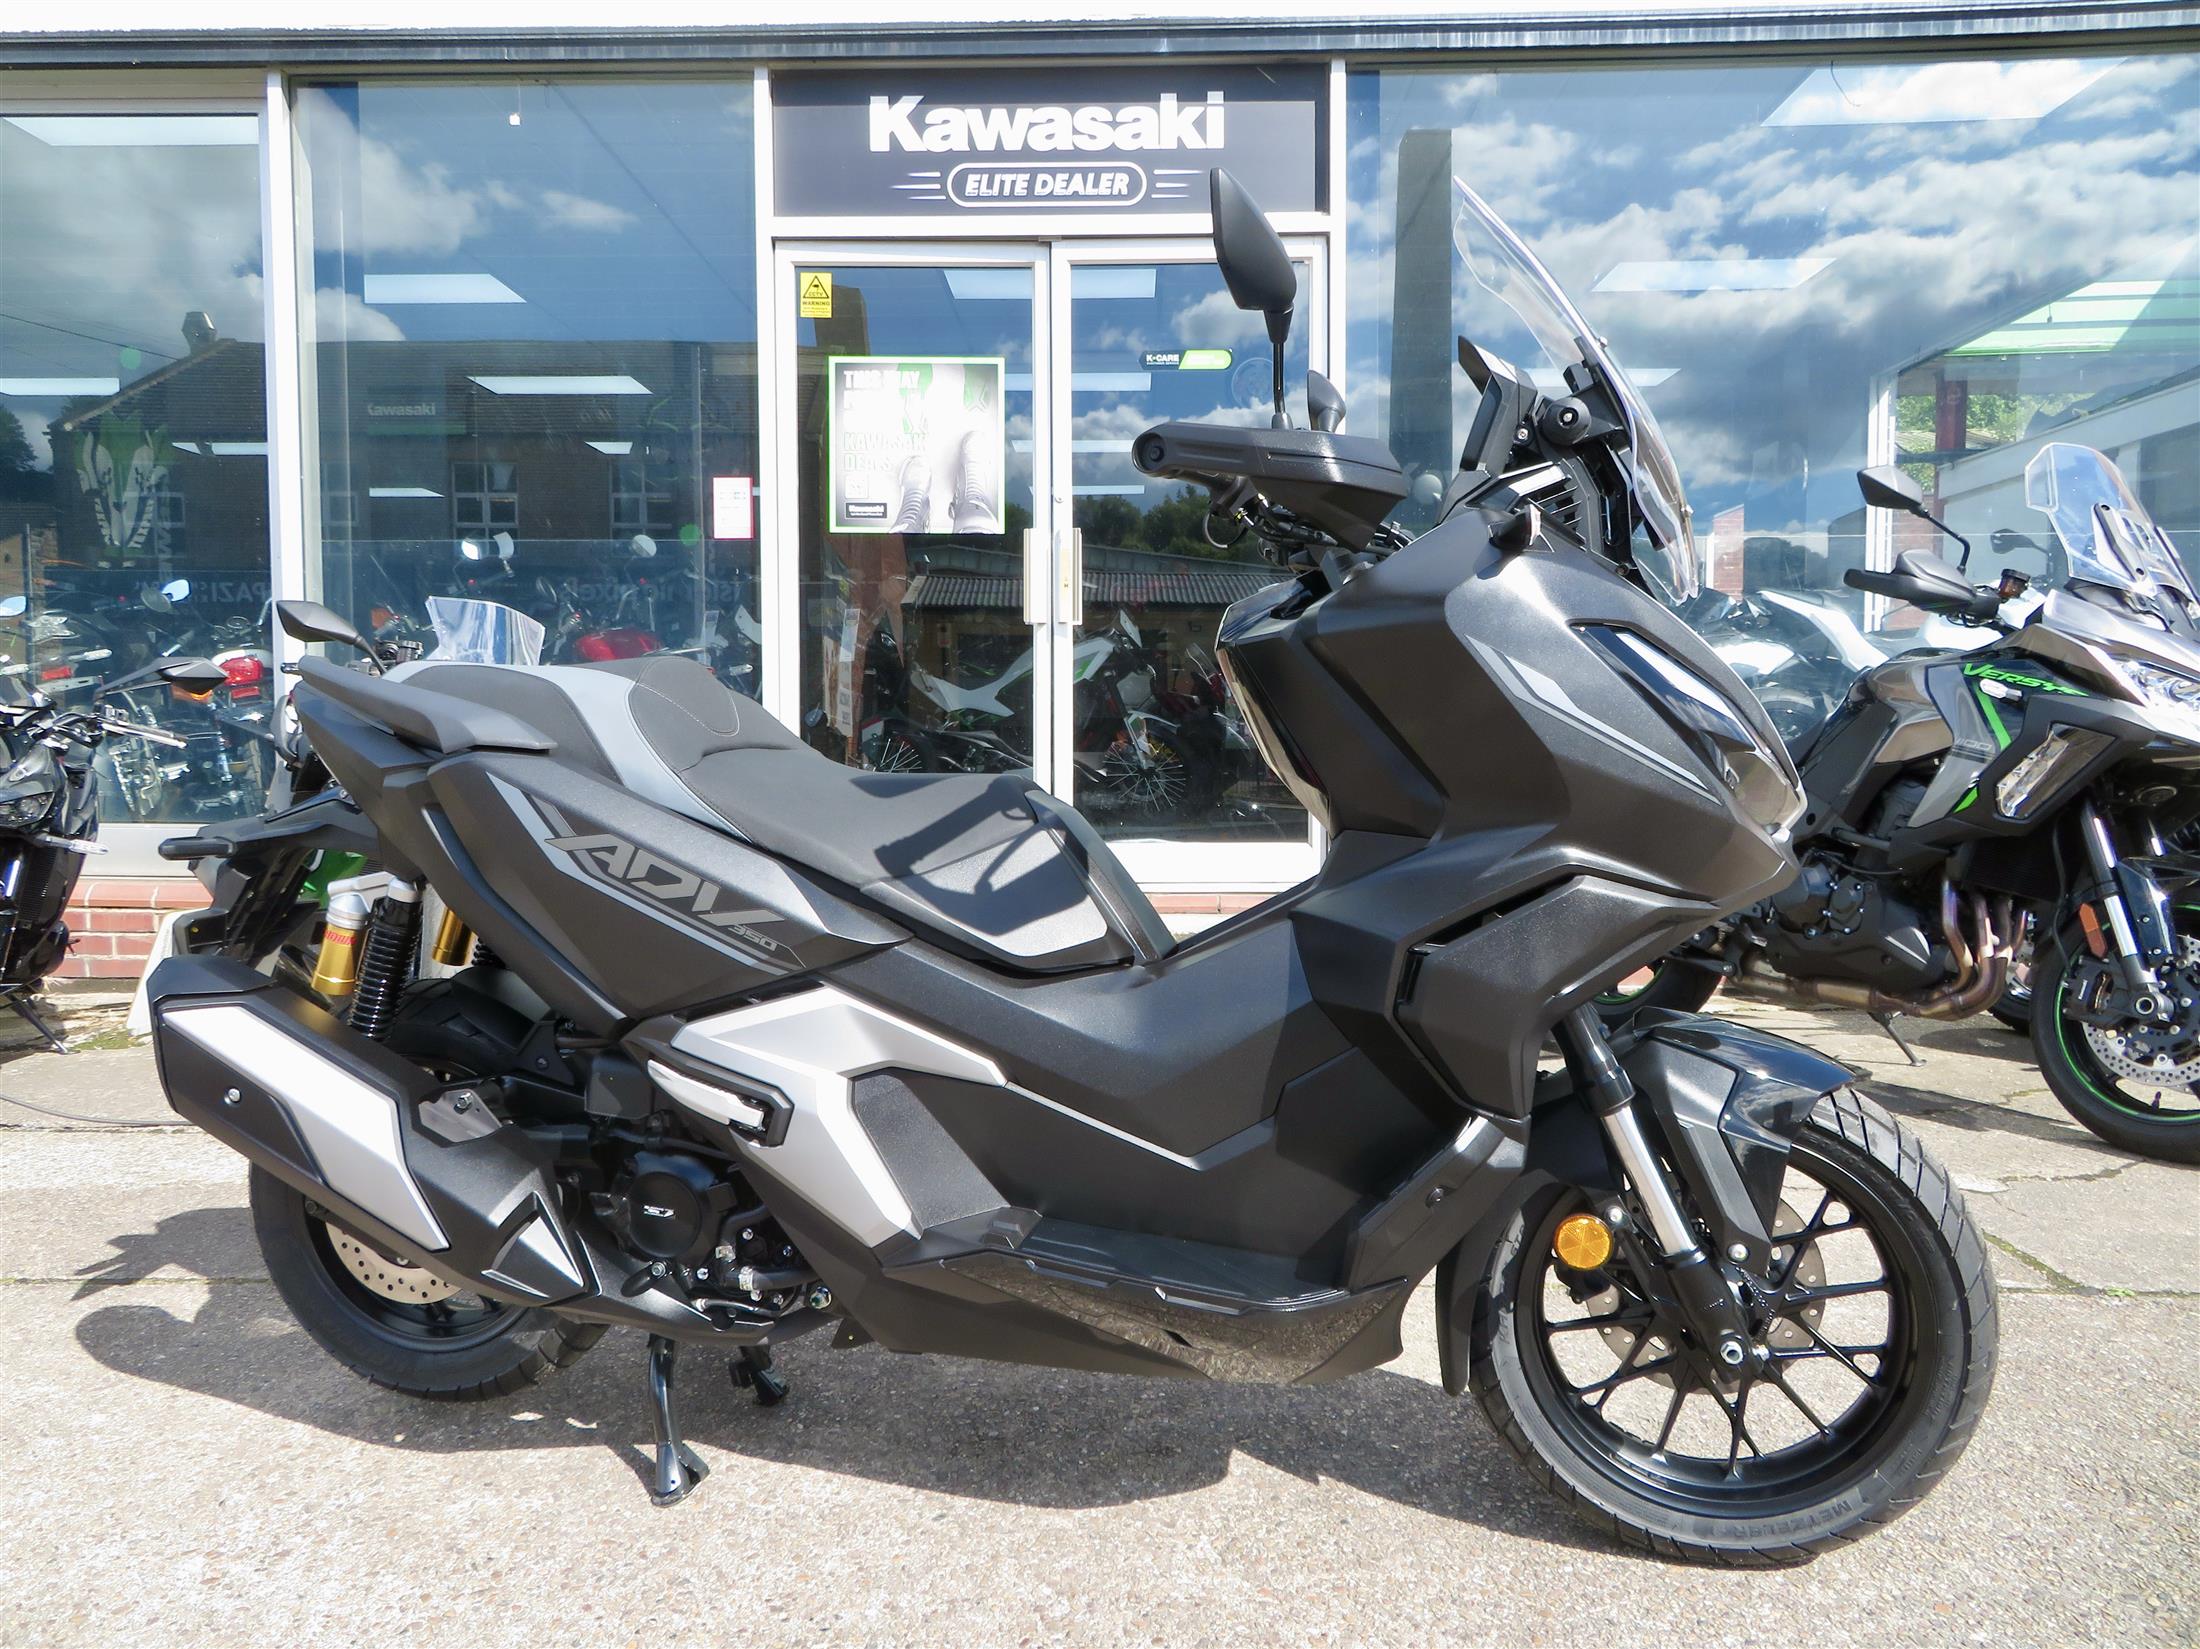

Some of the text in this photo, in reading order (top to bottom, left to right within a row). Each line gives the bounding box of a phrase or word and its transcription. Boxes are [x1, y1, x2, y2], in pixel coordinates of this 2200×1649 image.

[869, 91, 1225, 152] Kawasaki
[965, 172, 1130, 197] ELITE DEALER
[544, 834, 785, 926] ADV
[728, 924, 777, 951] 350
